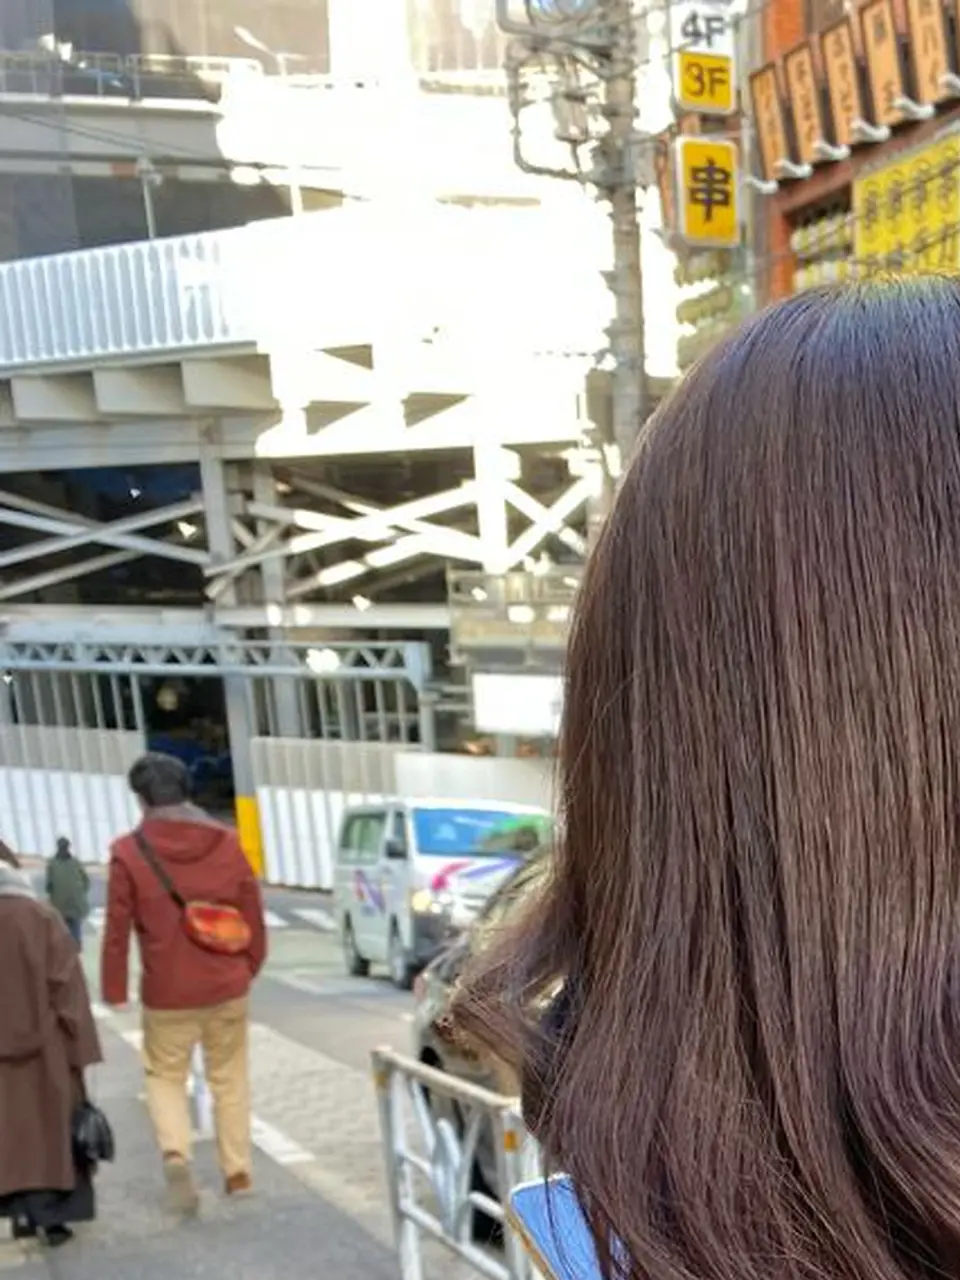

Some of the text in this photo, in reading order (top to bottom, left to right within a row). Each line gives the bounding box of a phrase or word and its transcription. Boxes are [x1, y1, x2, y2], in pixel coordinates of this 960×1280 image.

[681, 10, 725, 48] 4F
[685, 61, 729, 99] 3F
[689, 155, 731, 223] 串
